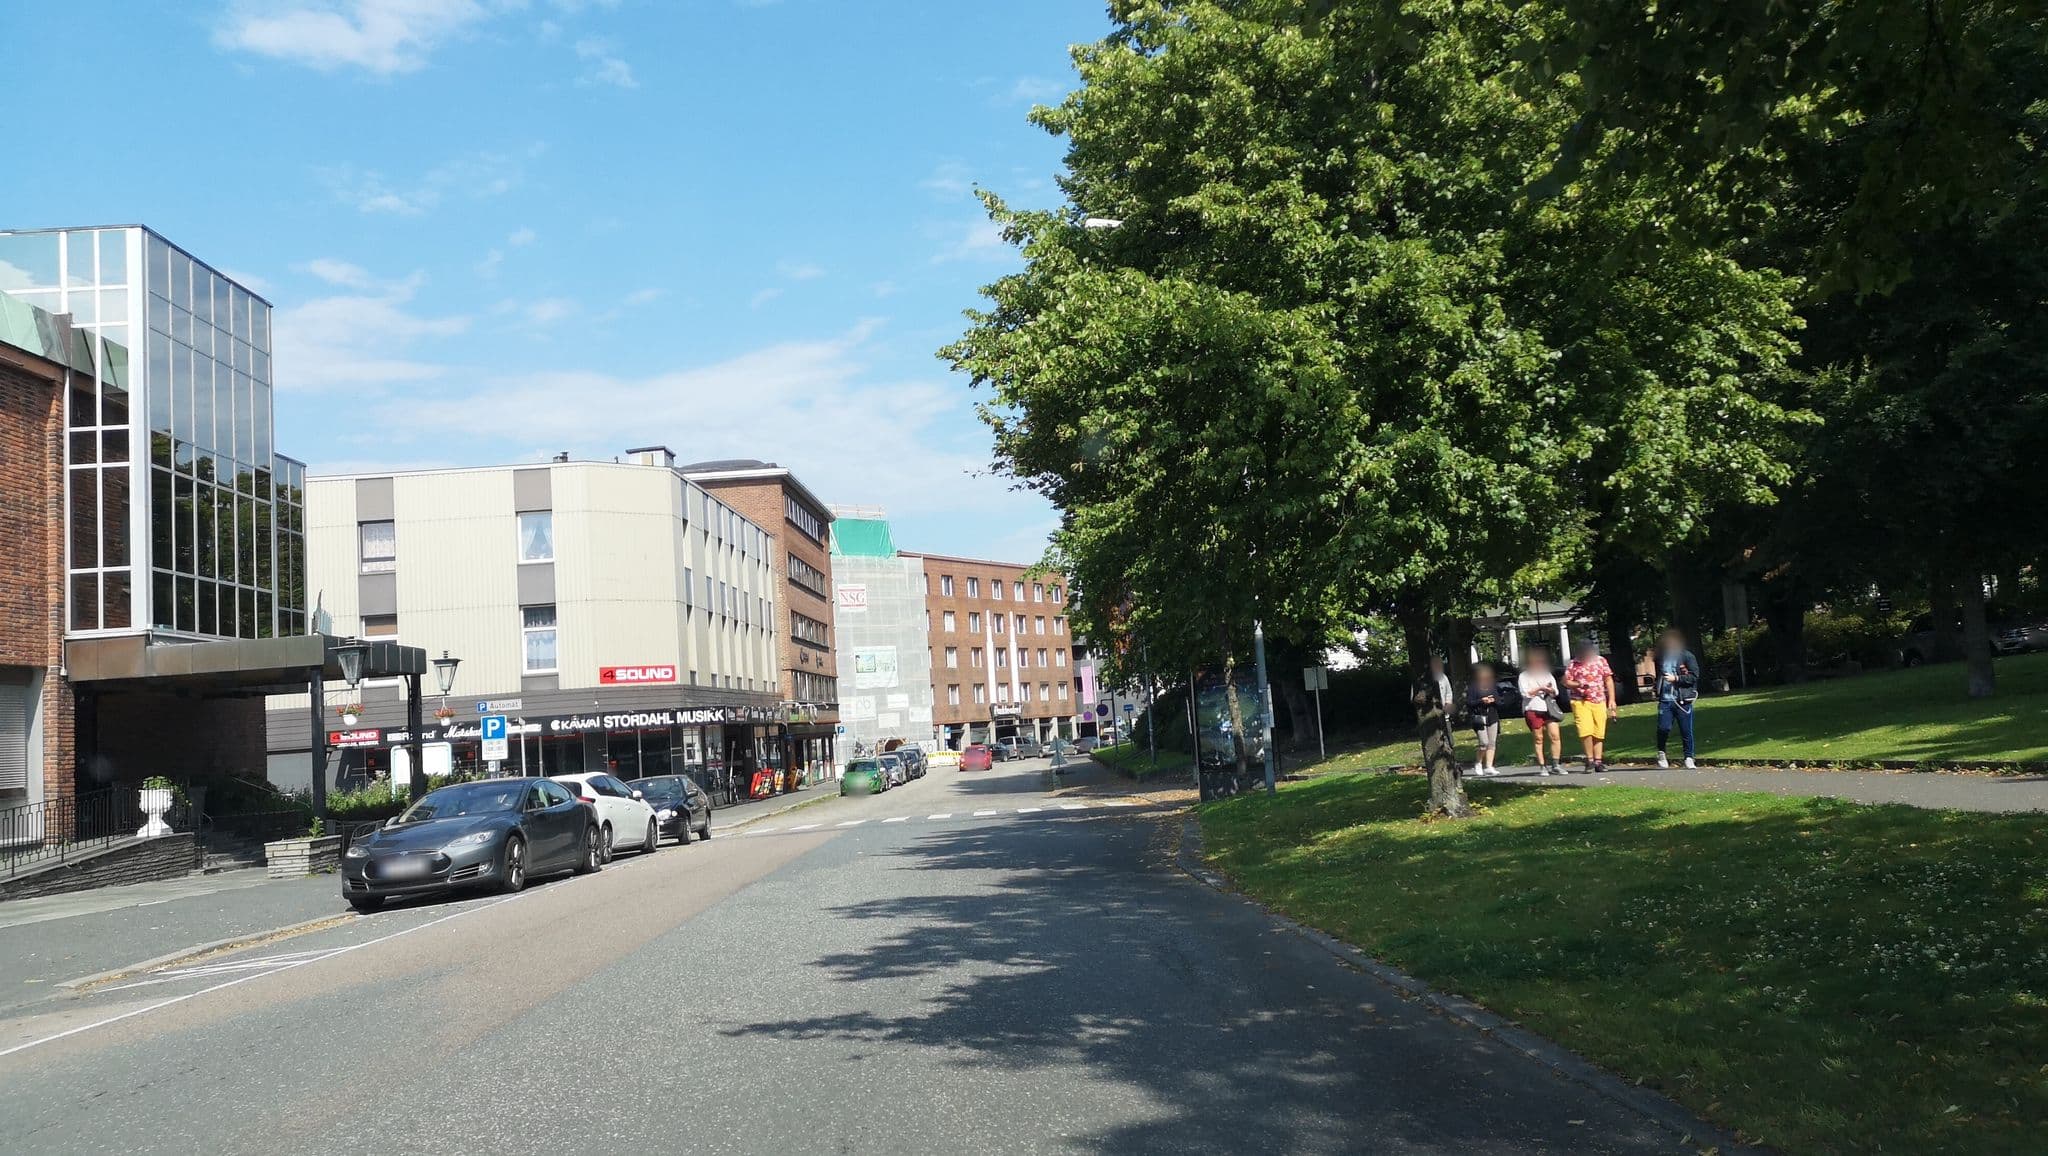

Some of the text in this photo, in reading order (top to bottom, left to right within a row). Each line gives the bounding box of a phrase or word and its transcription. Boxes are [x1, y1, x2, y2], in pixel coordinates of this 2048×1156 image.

[840, 592, 866, 603] NSG
[603, 668, 673, 681] 4SOUND
[561, 717, 600, 730] KAWAI
[603, 713, 674, 728] STORDAHL
[677, 709, 724, 724] MUSIKK
[487, 719, 500, 738] P
